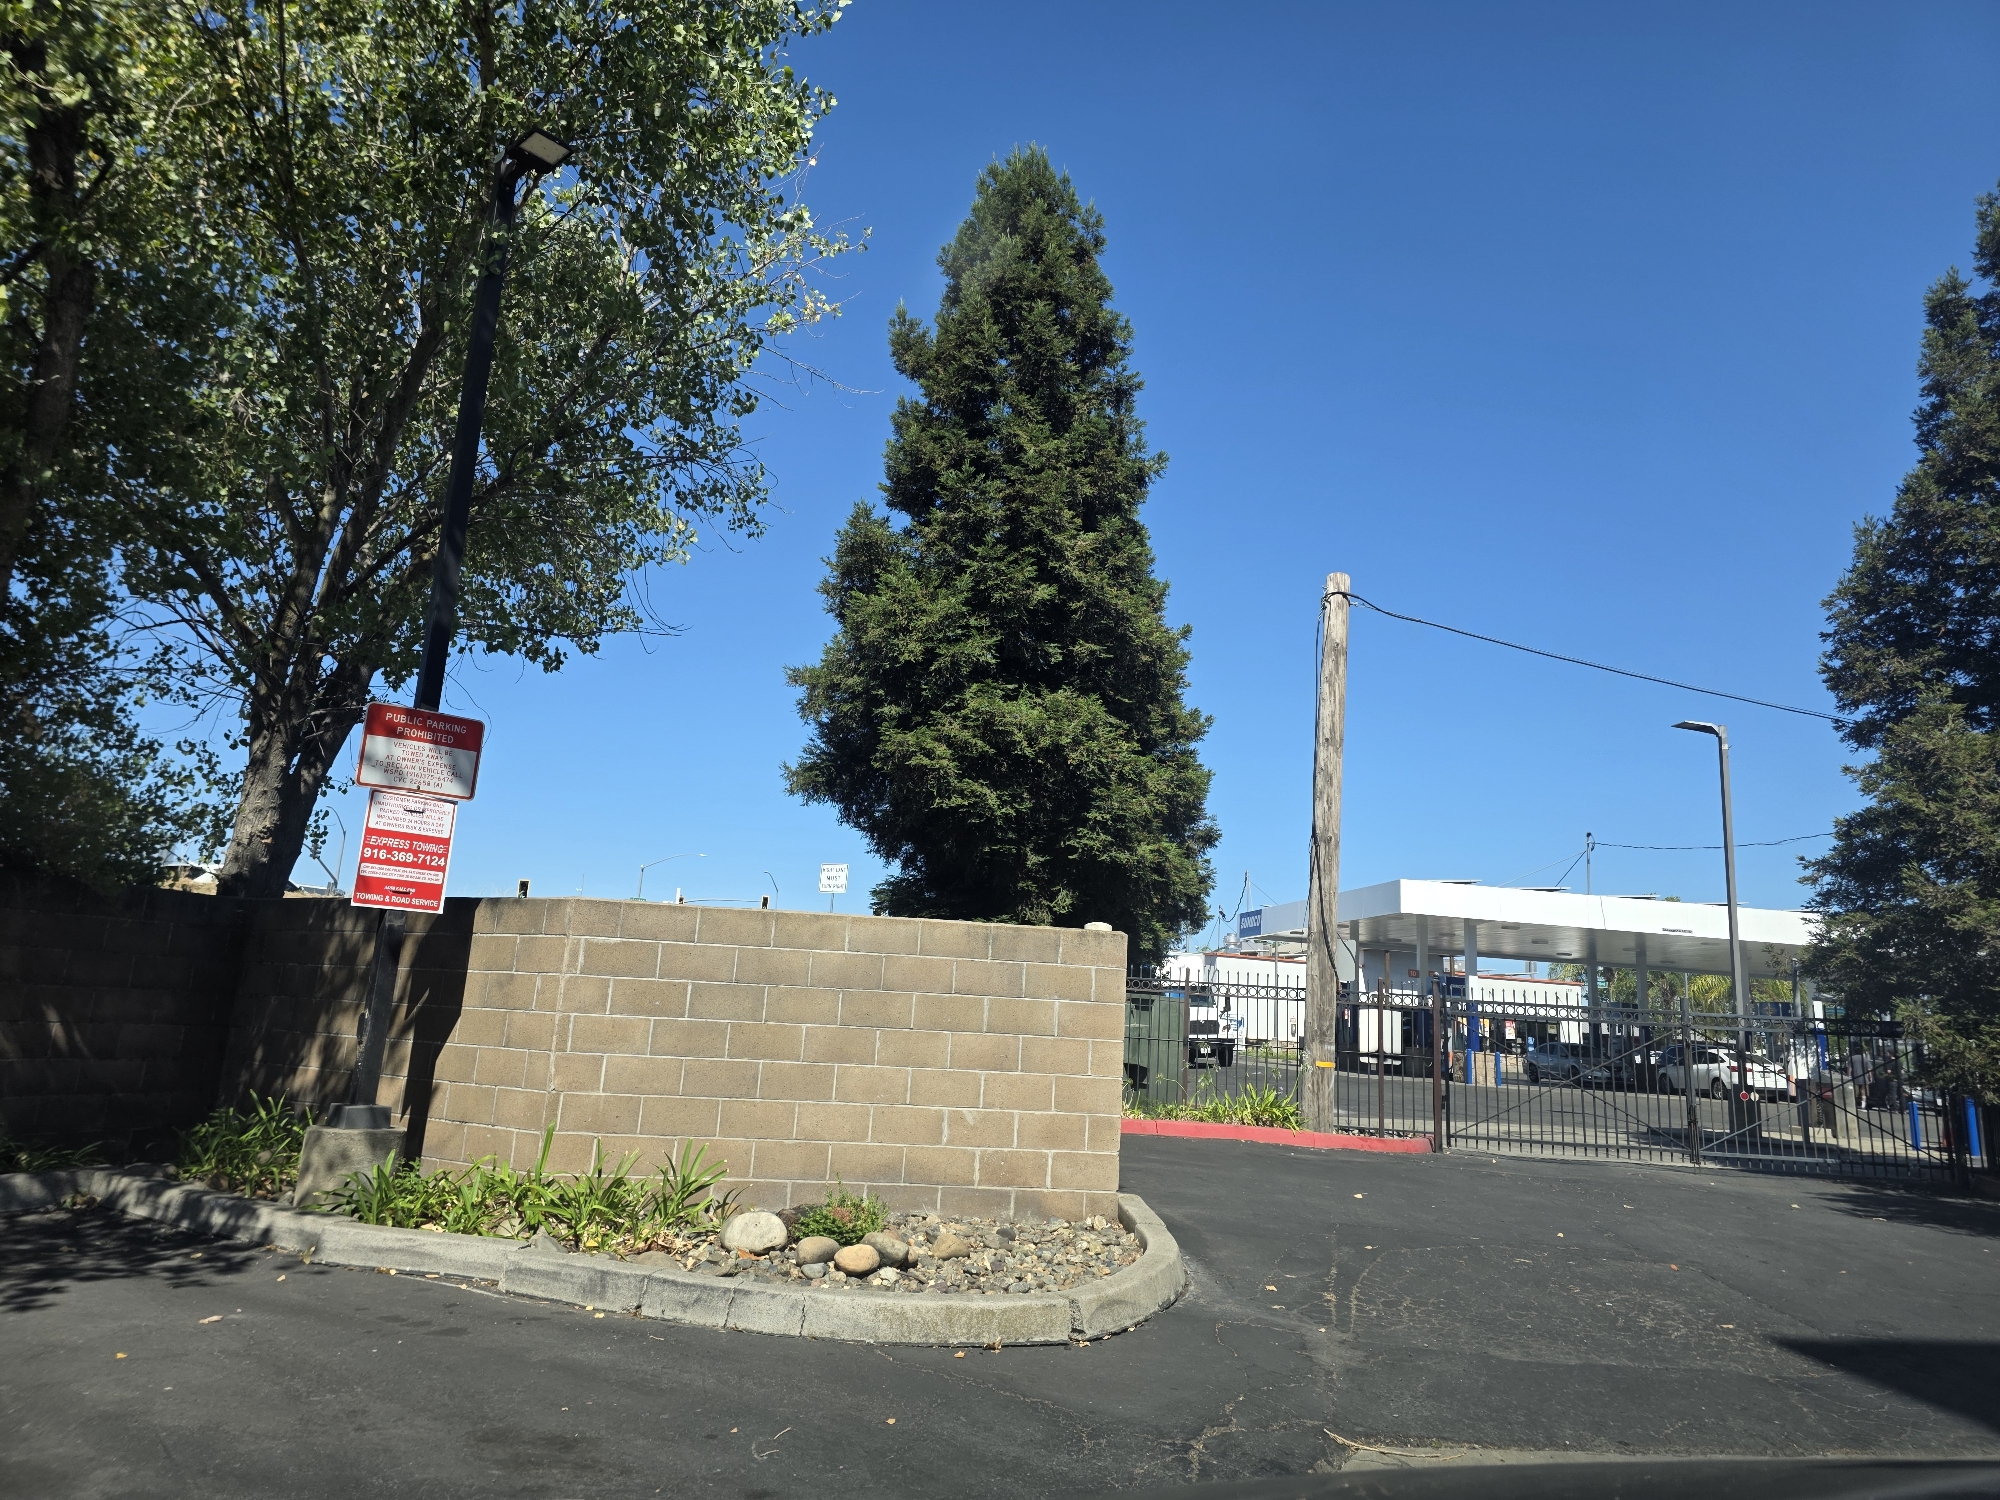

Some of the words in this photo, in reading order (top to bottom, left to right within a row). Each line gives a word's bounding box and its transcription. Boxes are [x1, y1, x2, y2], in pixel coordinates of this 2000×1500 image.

[386, 712, 422, 726] PUBLIC
[426, 719, 466, 734] PARKING
[396, 726, 454, 744] PROHIBITED
[394, 741, 426, 752] VEHICLES
[402, 750, 424, 758] TOWED
[386, 762, 416, 771] RECLAIM
[419, 766, 444, 776] VEHICLE
[396, 756, 425, 766] OWNER'S
[428, 761, 456, 770] EXPENSE
[370, 836, 410, 849] EXPRESS
[412, 841, 444, 853] TOWING
[364, 848, 445, 866] 916-369-7124
[356, 892, 383, 901] TOWING
[391, 896, 410, 904] ROAD
[411, 898, 438, 907] SERVICE
